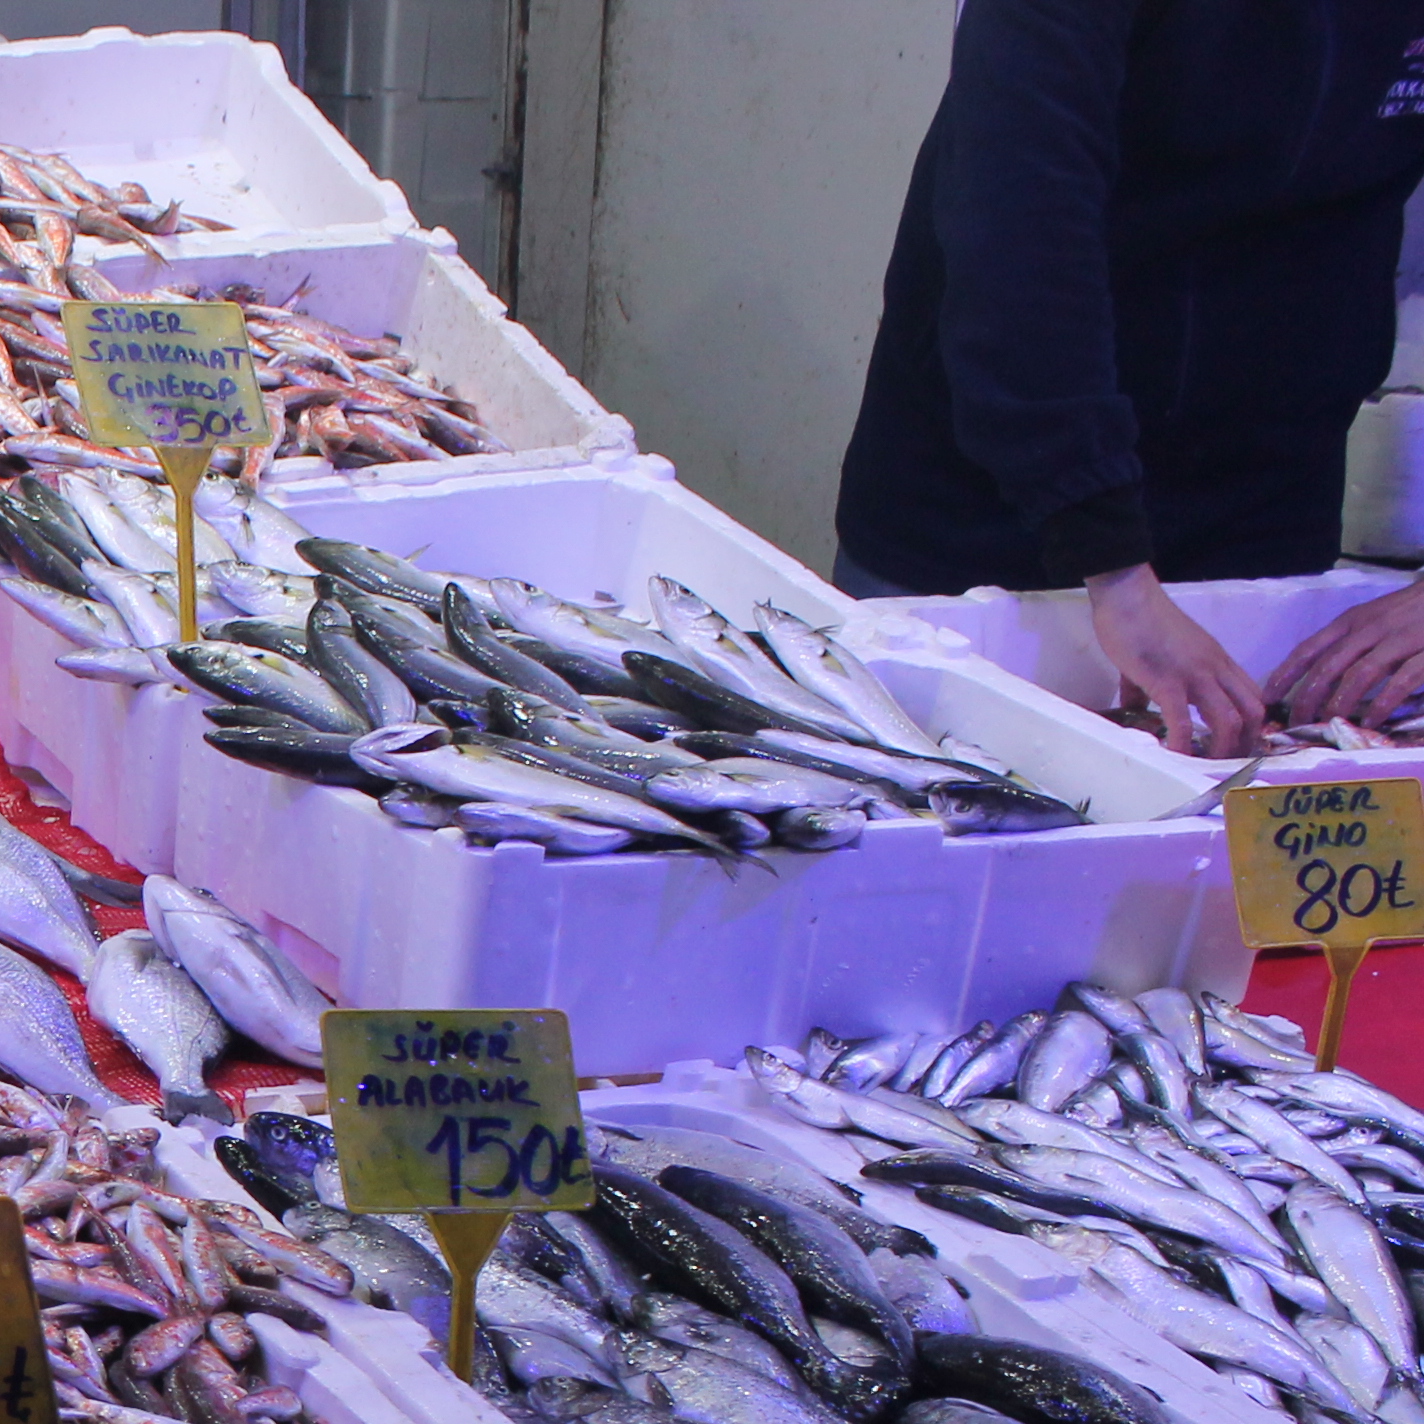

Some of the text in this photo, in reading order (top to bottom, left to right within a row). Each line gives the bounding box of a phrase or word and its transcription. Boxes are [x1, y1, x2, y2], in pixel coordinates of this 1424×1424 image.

[85, 306, 196, 334] SÜPER
[80, 339, 248, 370] SARIKANAT
[1269, 785, 1380, 818] SÜPER
[382, 1020, 522, 1064] SÜPER
